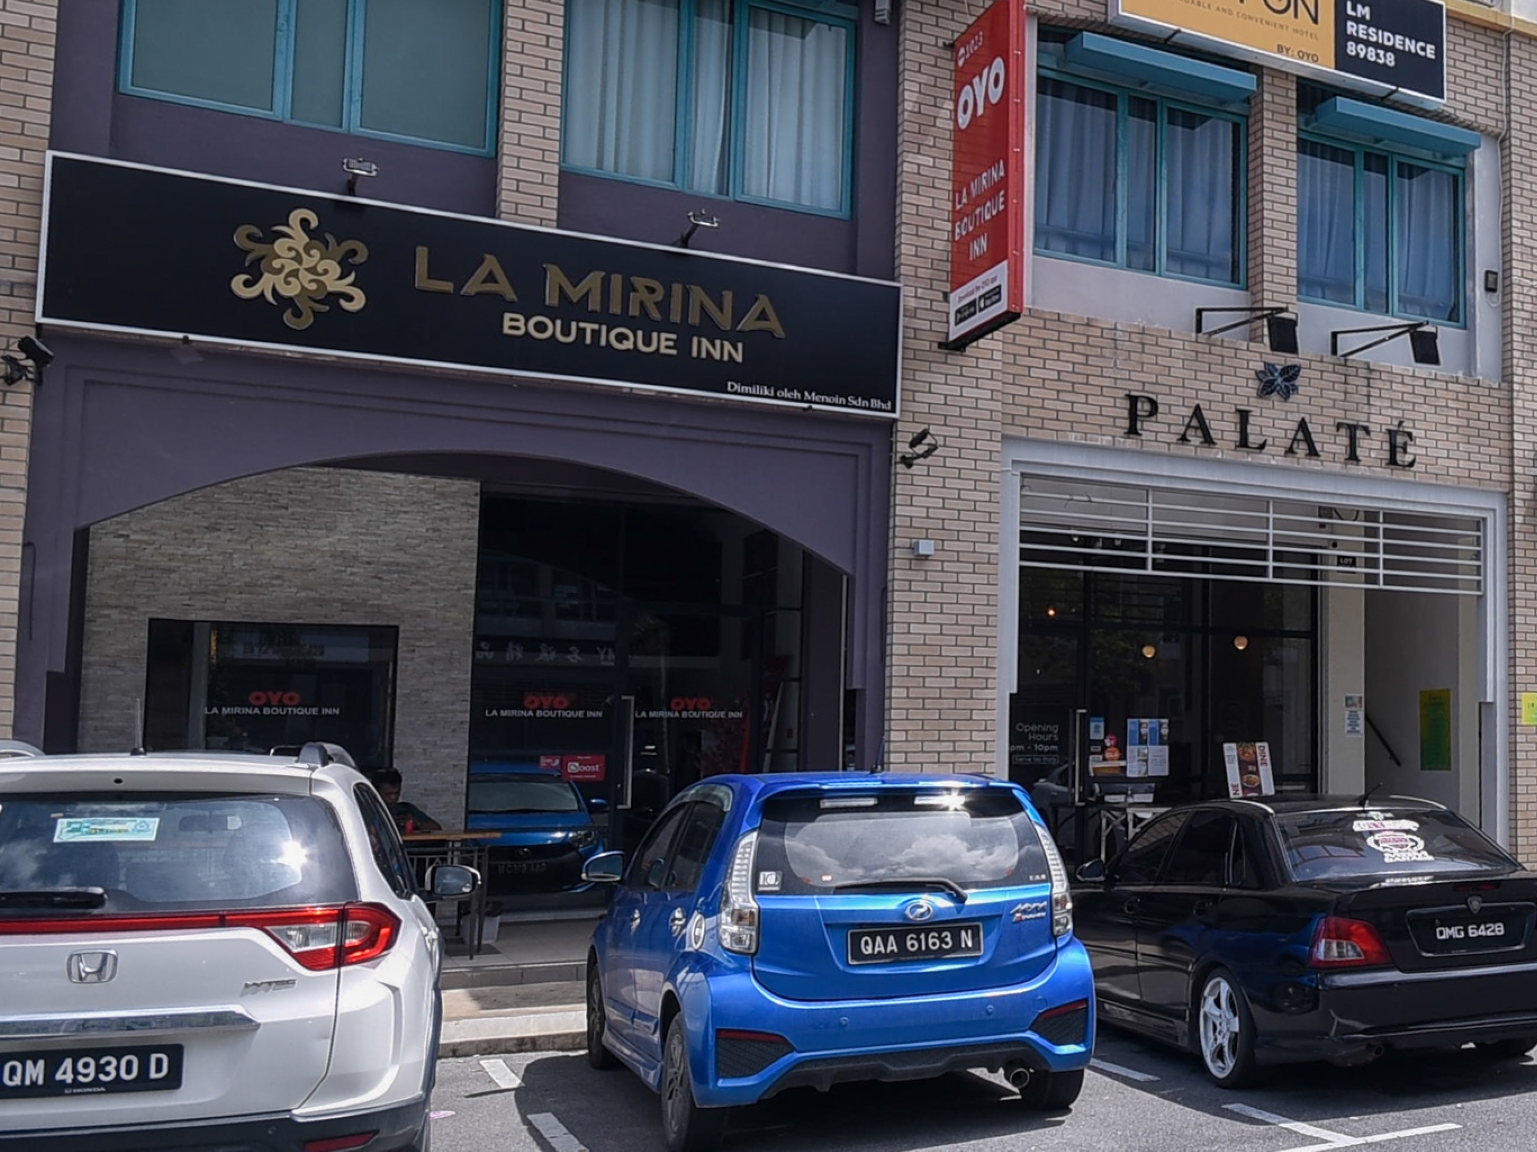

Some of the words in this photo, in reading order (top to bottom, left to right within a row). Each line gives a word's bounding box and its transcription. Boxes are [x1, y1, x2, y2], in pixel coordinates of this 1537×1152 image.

[1346, 0, 1371, 20] LM
[1215, 5, 1234, 16] AND
[1236, 11, 1290, 32] CONVENIENT
[1292, 27, 1319, 41] HOTEL
[1346, 21, 1436, 60] RESIDENCE
[1297, 50, 1319, 63] OYO
[1346, 42, 1396, 67] 89838
[957, 56, 1005, 130] OYO
[955, 187, 968, 211] LA
[970, 159, 1005, 198] MIRINA
[955, 190, 1005, 242] BOUTIQUE
[969, 232, 988, 261] INN
[414, 245, 517, 303] LA
[542, 263, 786, 339] MIRINA
[502, 311, 679, 356] BOUTIQUE
[690, 335, 744, 364] INN
[726, 381, 775, 397] Dimiliki
[776, 388, 801, 400] oleh
[848, 395, 869, 408] Sdn
[870, 398, 891, 410] Bhd
[1123, 391, 1418, 469] PALATÉ
[204, 706, 219, 715] LA
[221, 706, 261, 715] MIRINA
[263, 707, 319, 715] BOUTIQUE
[322, 707, 340, 715] INN
[249, 691, 301, 706] OYO
[524, 695, 570, 709] OYO
[670, 697, 711, 711] OYO
[485, 709, 498, 717] LA
[500, 709, 534, 717] MIRINA
[536, 710, 585, 718] BOUTIQUE
[587, 710, 603, 718] INN
[635, 710, 647, 719] LA
[681, 710, 726, 719] BOUTIQUE
[1015, 722, 1059, 734] Opening
[1028, 732, 1059, 741] Hours
[860, 935, 898, 955] QAA
[906, 930, 953, 952] 6163
[961, 929, 973, 948] N
[1468, 922, 1505, 937] 6428
[2, 1059, 45, 1087] QM
[55, 1054, 140, 1084] 4930
[149, 1053, 169, 1079] D
